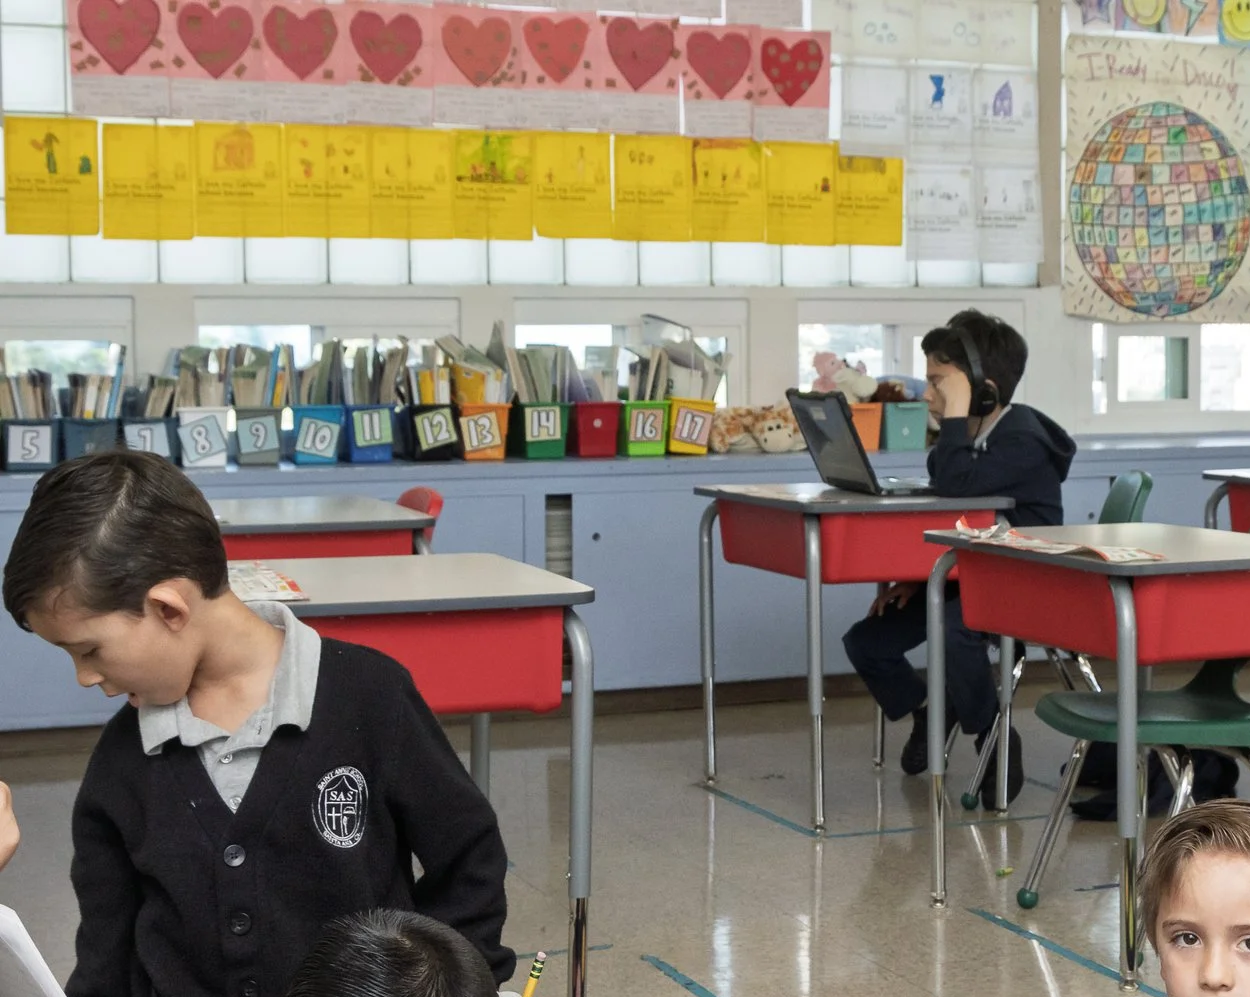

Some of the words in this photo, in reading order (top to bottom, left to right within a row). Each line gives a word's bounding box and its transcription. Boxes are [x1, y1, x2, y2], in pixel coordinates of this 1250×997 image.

[249, 422, 269, 449] 9
[302, 418, 334, 452] 10
[361, 411, 382, 442] 11
[422, 415, 452, 445] 12
[467, 415, 495, 446] 13
[530, 409, 557, 436] 14
[634, 411, 658, 439] 16
[678, 410, 704, 440] 17
[21, 430, 41, 460] 5
[190, 424, 213, 455] 8
[329, 790, 354, 802] SAS
